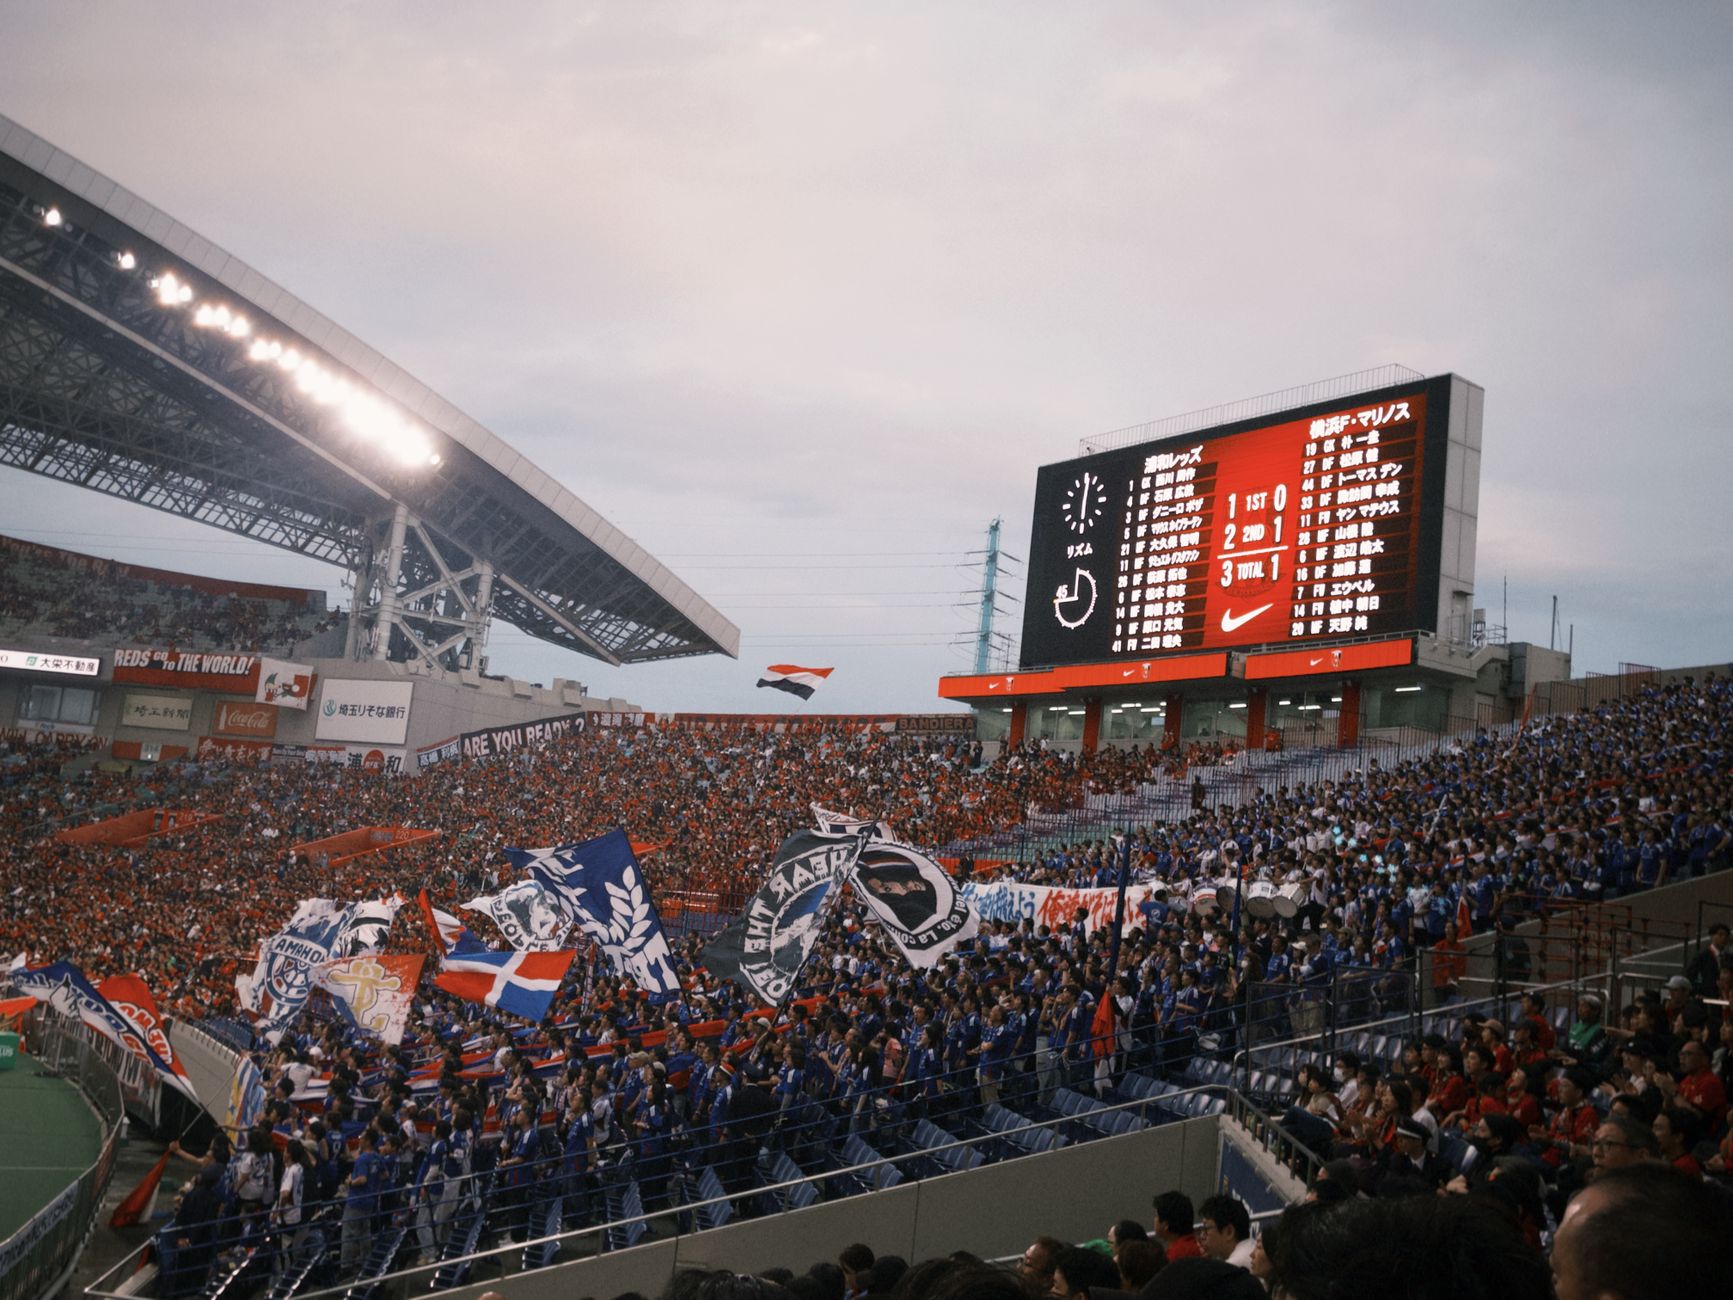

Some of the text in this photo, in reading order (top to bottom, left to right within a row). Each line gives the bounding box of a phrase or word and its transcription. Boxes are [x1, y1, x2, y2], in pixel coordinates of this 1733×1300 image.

[1306, 443, 1316, 456] 19
[1304, 460, 1315, 474] 27
[1323, 457, 1334, 470] DF
[1302, 463, 1402, 491] 44 DF トーマス デン
[1130, 480, 1133, 491] 1
[1127, 496, 1132, 507] 4
[1229, 484, 1286, 519] 1 1ST 0
[1301, 496, 1313, 510] 33
[1320, 493, 1331, 506] DF
[1301, 514, 1310, 527] 11
[1336, 508, 1356, 521] ヤン
[1358, 499, 1399, 517] マテウス
[1124, 528, 1130, 539] 5
[1224, 516, 1282, 550] 2 2ND 1
[1068, 543, 1092, 558] リズム
[1121, 544, 1130, 555] 21
[1300, 550, 1306, 563] 6
[1121, 560, 1128, 571] 11
[1221, 554, 1279, 587] 3 TOTAL 1
[1297, 568, 1307, 581] 16
[1315, 565, 1326, 579] DF
[1056, 585, 1069, 598] 45
[1298, 587, 1303, 599] 7
[1331, 579, 1376, 597] エウベル
[1119, 592, 1124, 603] 6
[1116, 607, 1125, 619] 14
[1295, 604, 1305, 617] 14
[1292, 622, 1304, 635] 20
[1112, 641, 1121, 652] 41
[40, 658, 96, 673] 大栄不動産
[113, 649, 254, 675] REDS GO TO THE WORLD!
[134, 704, 189, 718] 埼玉新聞
[338, 704, 406, 719] 埼玉りそな銀行
[899, 718, 974, 731] BANDIERA
[463, 733, 491, 758] ARE
[491, 728, 522, 753] YOU
[385, 755, 402, 774] 和
[918, 930, 938, 944] La
